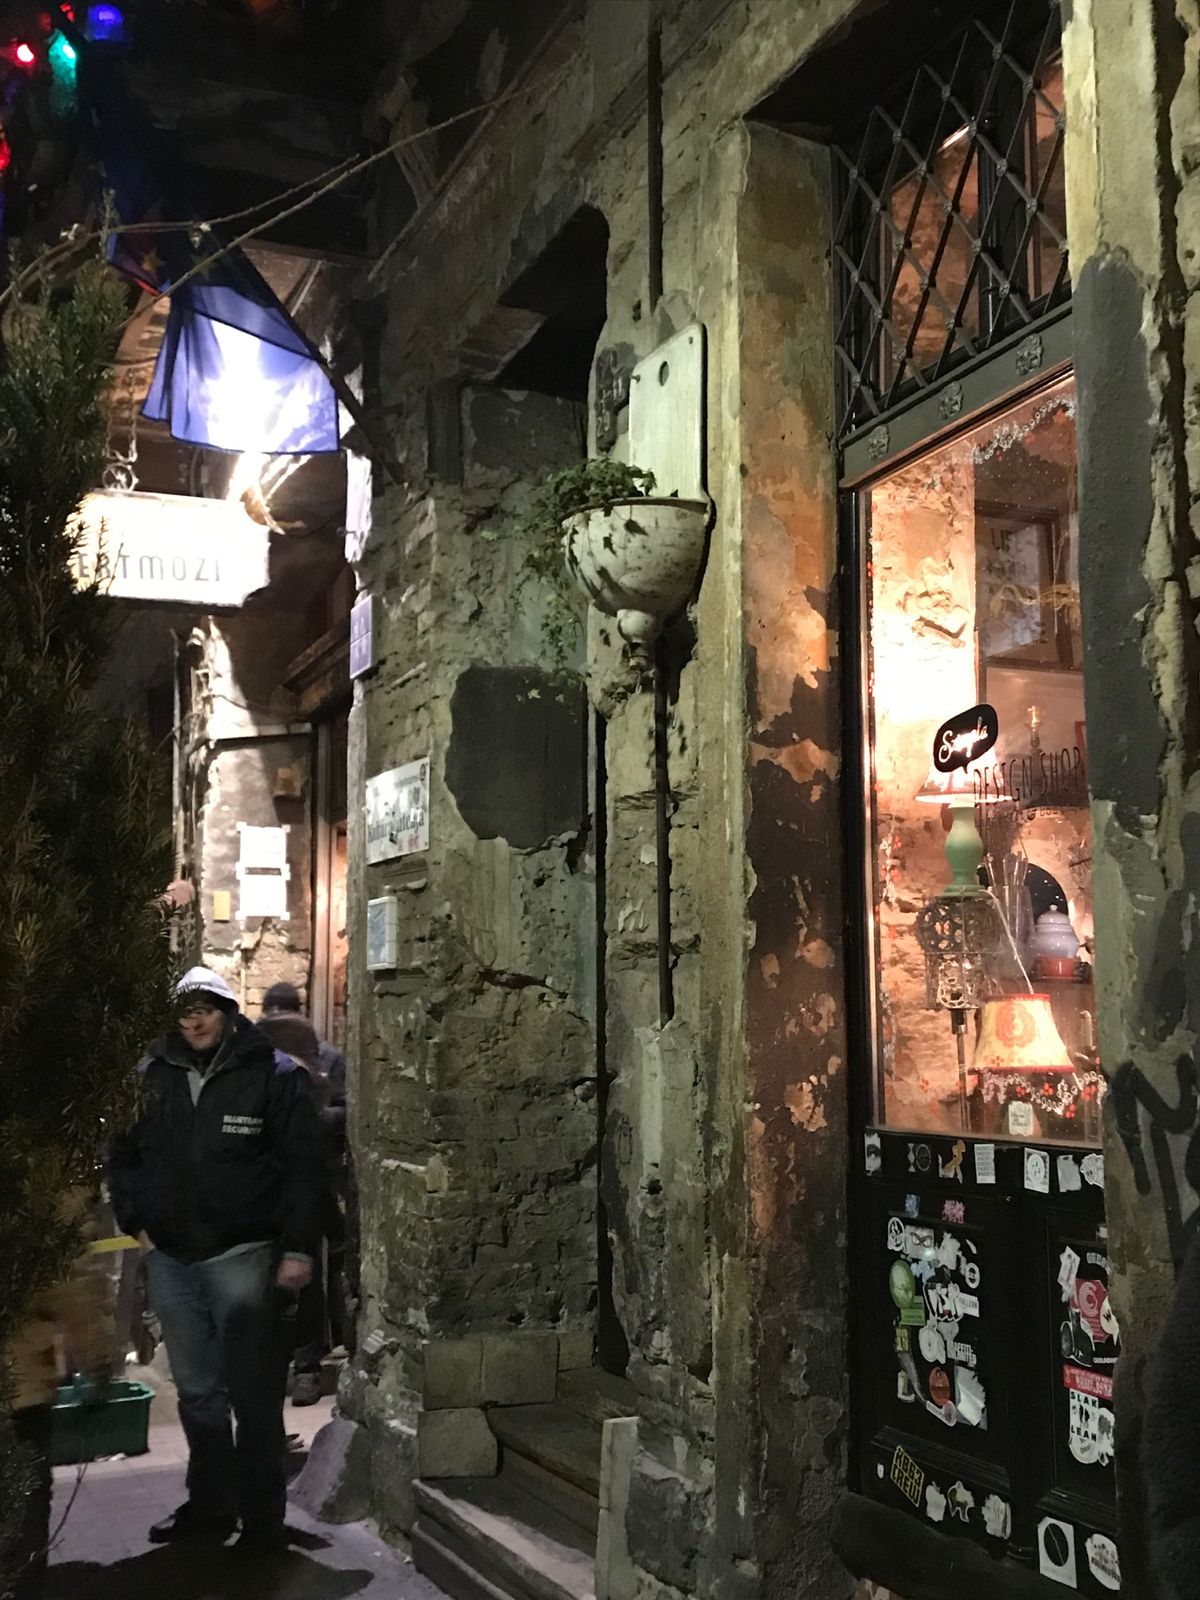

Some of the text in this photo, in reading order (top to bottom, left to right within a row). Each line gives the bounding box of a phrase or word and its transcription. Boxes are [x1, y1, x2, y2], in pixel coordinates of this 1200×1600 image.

[78, 553, 220, 582] ERTMOZI
[974, 746, 1081, 808] DESIGN SHOP
[1070, 1391, 1098, 1408] SLAK
[1070, 1424, 1097, 1442] LEAN
